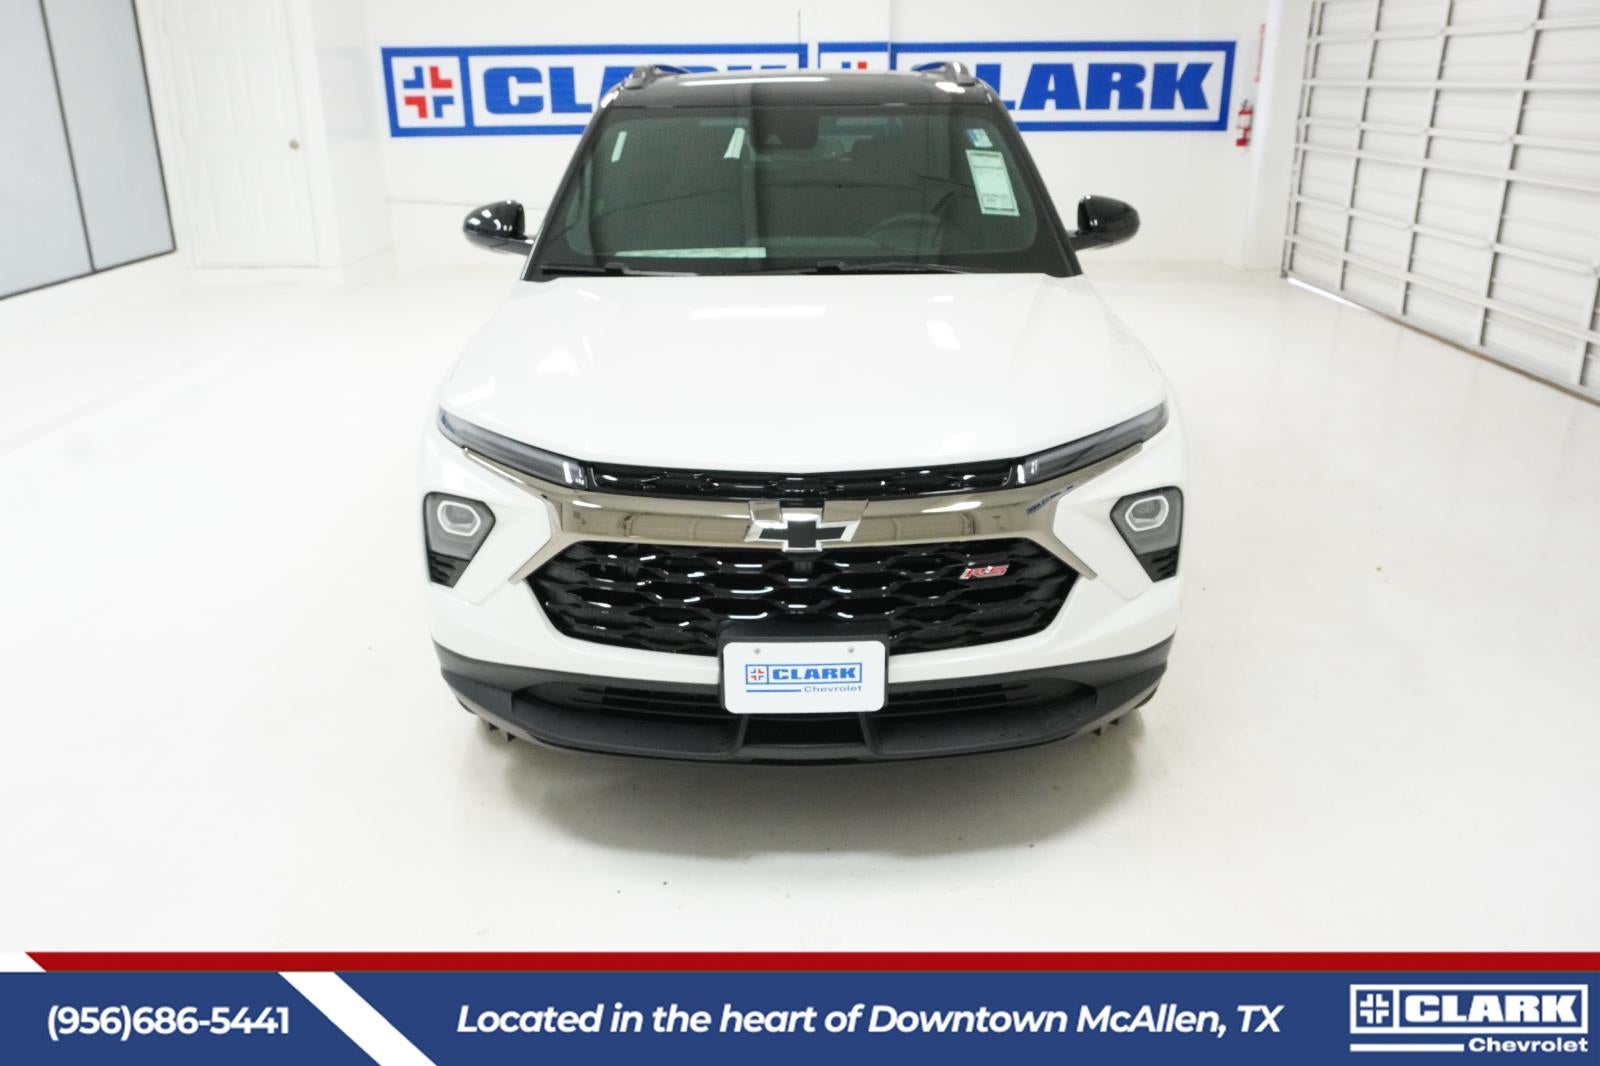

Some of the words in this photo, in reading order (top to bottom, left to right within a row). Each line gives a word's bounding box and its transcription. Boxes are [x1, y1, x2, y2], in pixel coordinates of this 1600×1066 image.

[916, 62, 1212, 110] LARK
[960, 565, 1009, 580] RS
[772, 667, 857, 680] CLARK
[803, 684, 862, 693] Chevrolet
